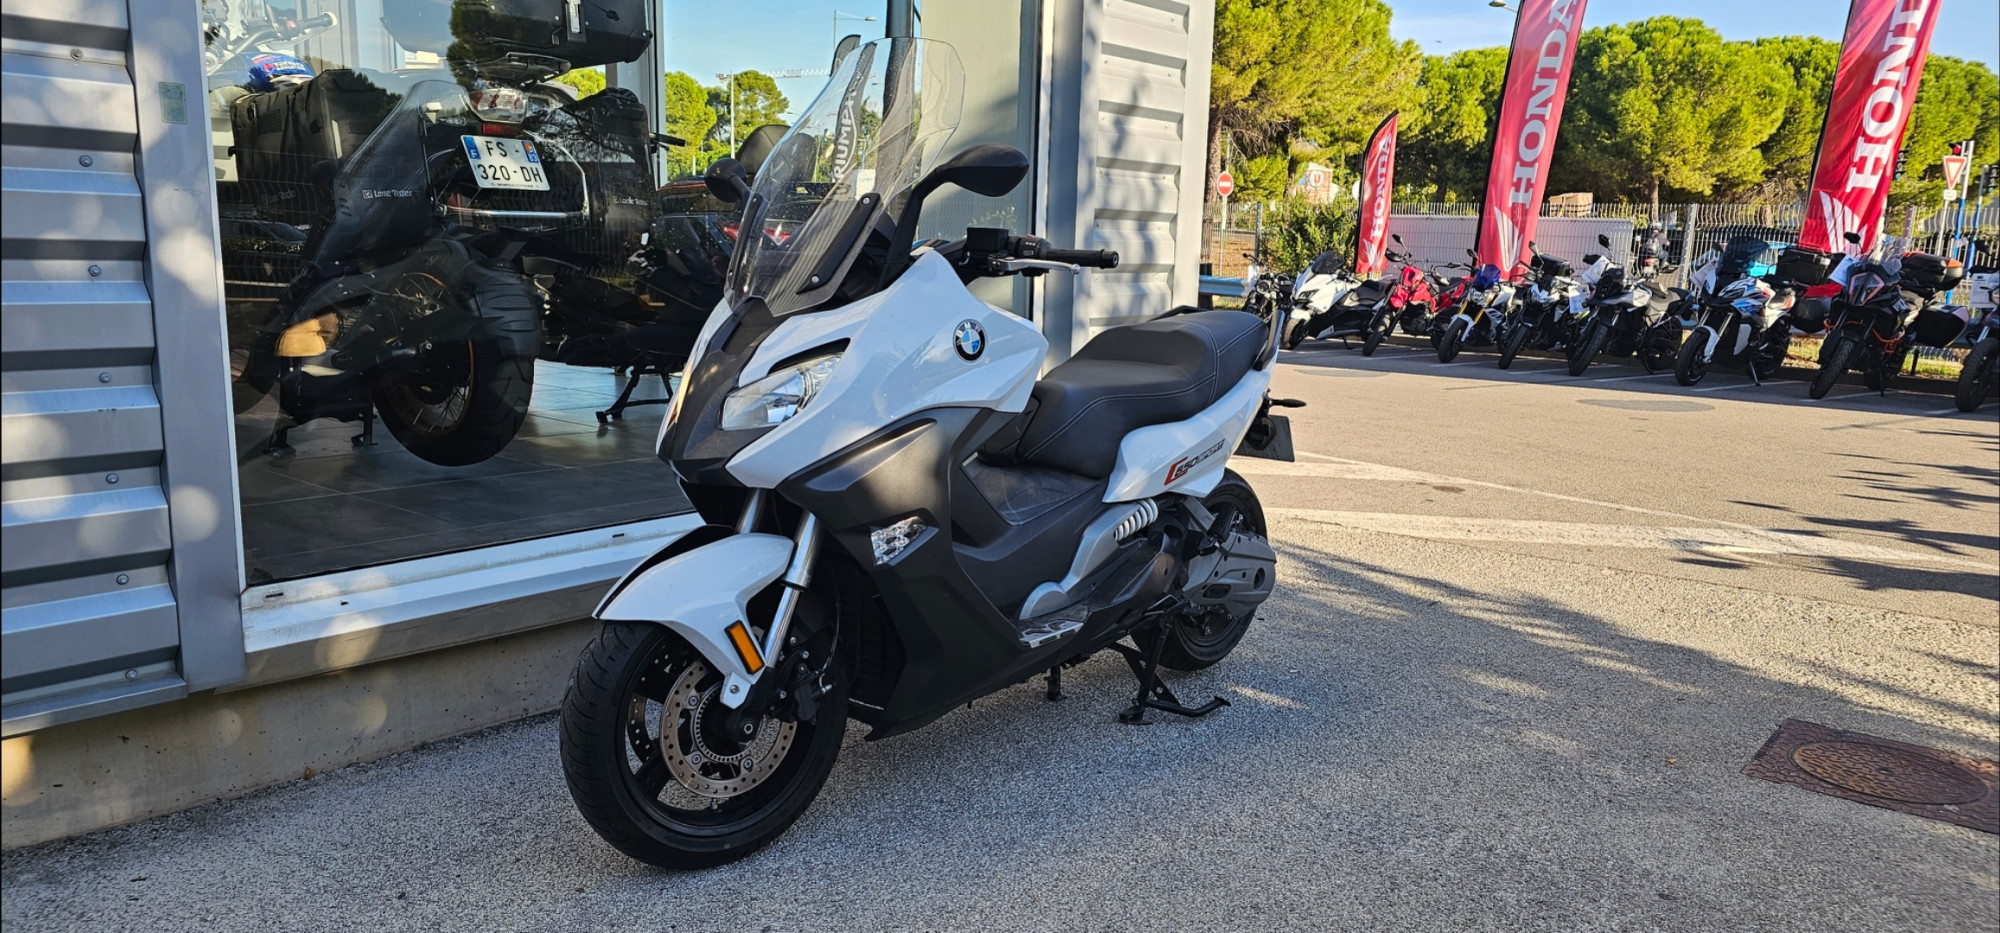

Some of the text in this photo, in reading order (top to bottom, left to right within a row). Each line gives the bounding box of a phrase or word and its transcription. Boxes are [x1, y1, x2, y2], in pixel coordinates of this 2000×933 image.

[484, 140, 508, 157] FS
[1508, 0, 1577, 210] HONDA
[1370, 132, 1392, 239] HONDA
